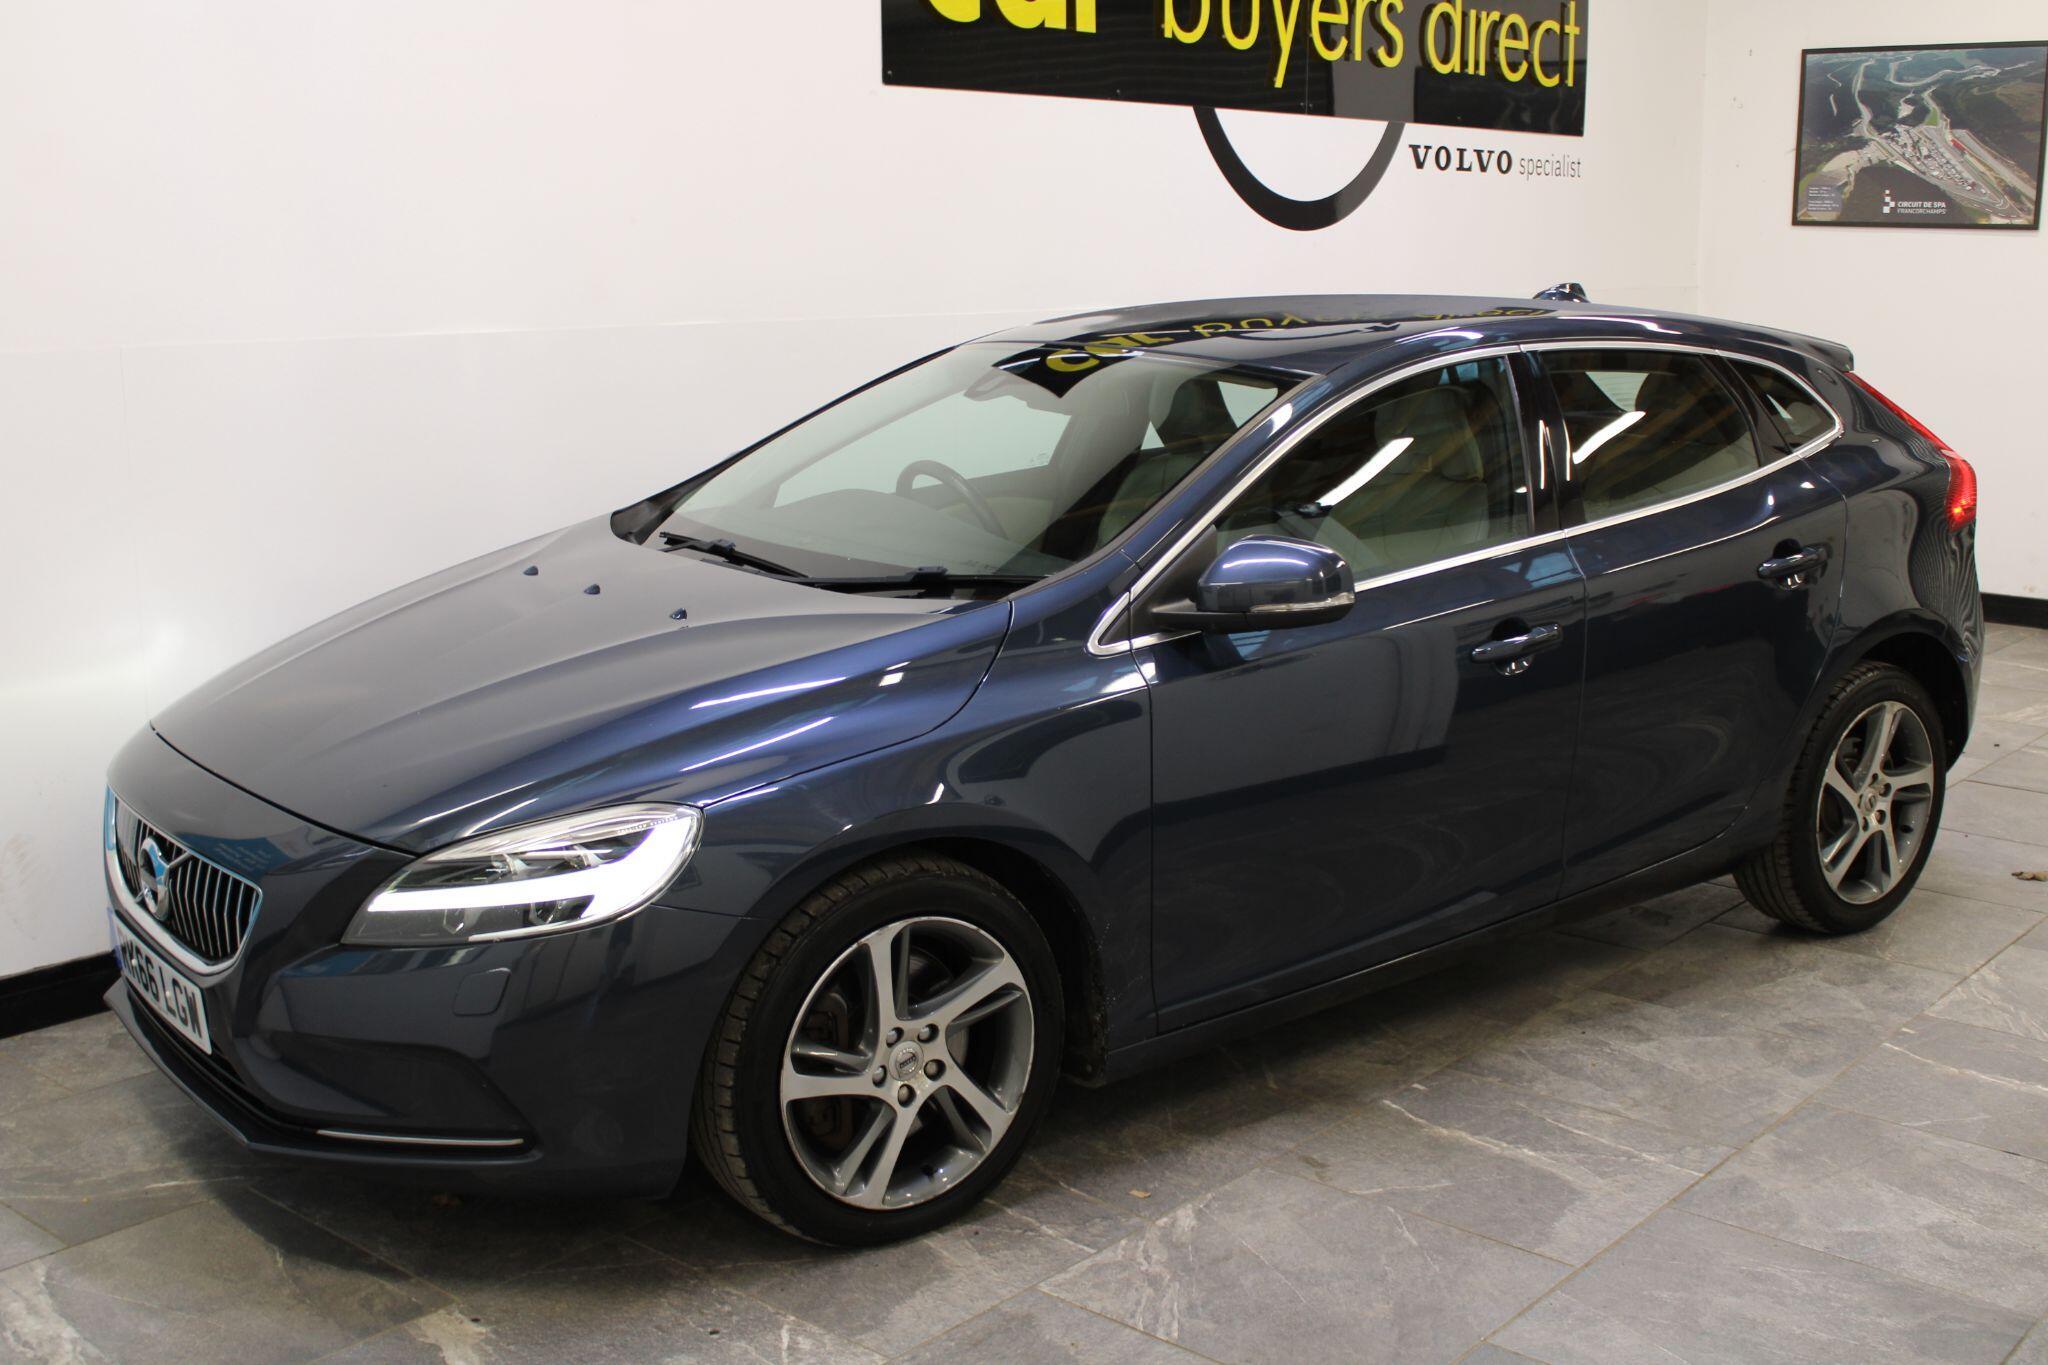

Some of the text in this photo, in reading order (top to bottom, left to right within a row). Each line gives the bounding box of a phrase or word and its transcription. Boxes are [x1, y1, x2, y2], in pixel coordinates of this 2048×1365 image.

[1426, 0, 1580, 87] direct
[1408, 144, 1581, 181] VOLVO specialist
